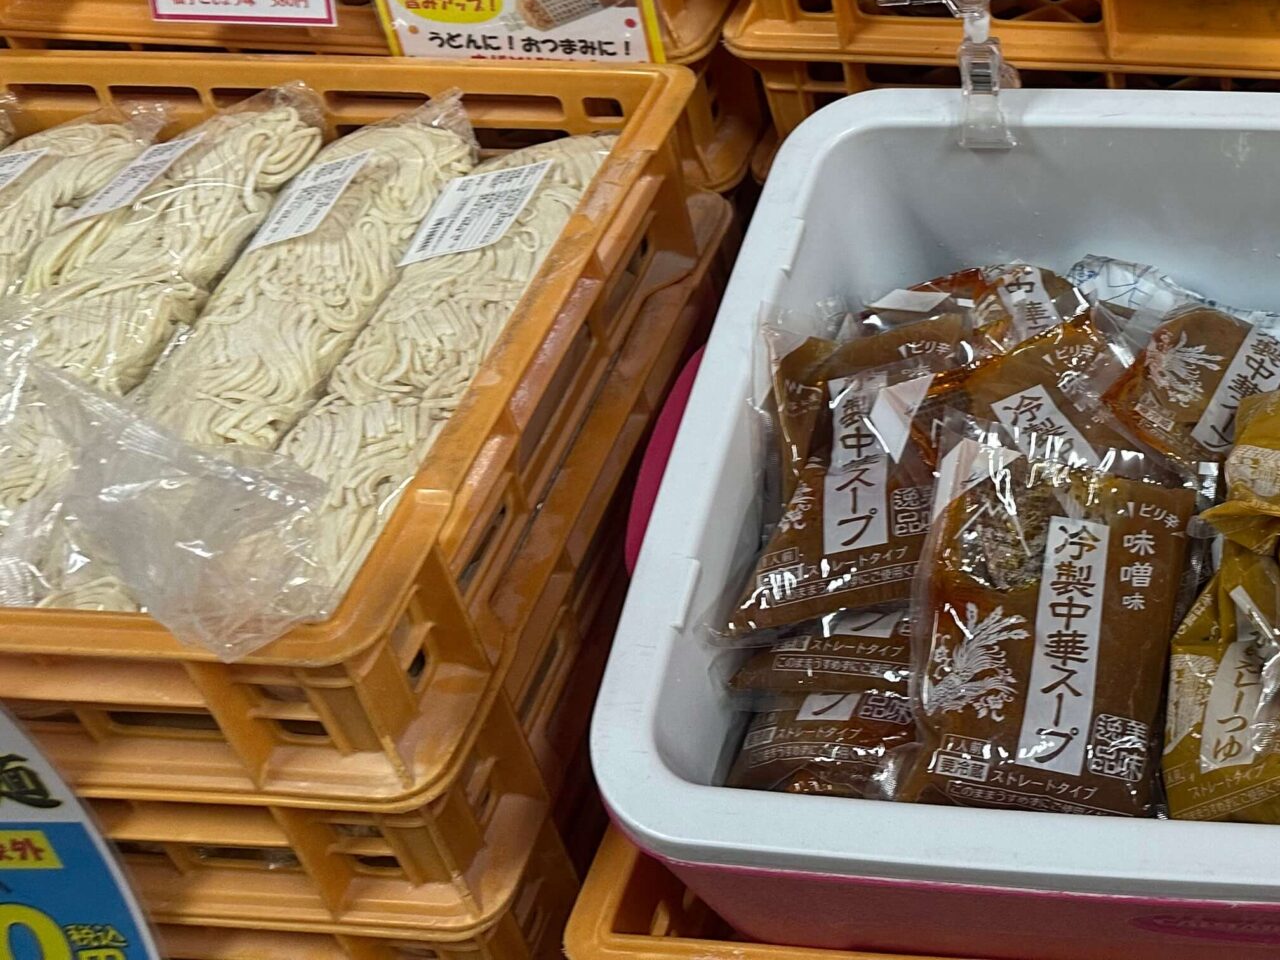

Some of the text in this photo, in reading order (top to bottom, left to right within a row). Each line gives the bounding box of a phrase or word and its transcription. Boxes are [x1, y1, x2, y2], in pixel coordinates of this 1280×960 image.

[1139, 506, 1181, 529] ピリ辛
[810, 639, 904, 656] ストレートタイプ
[1034, 524, 1102, 764] 冷製中華スープ
[990, 770, 1098, 800] ストレートタイプ
